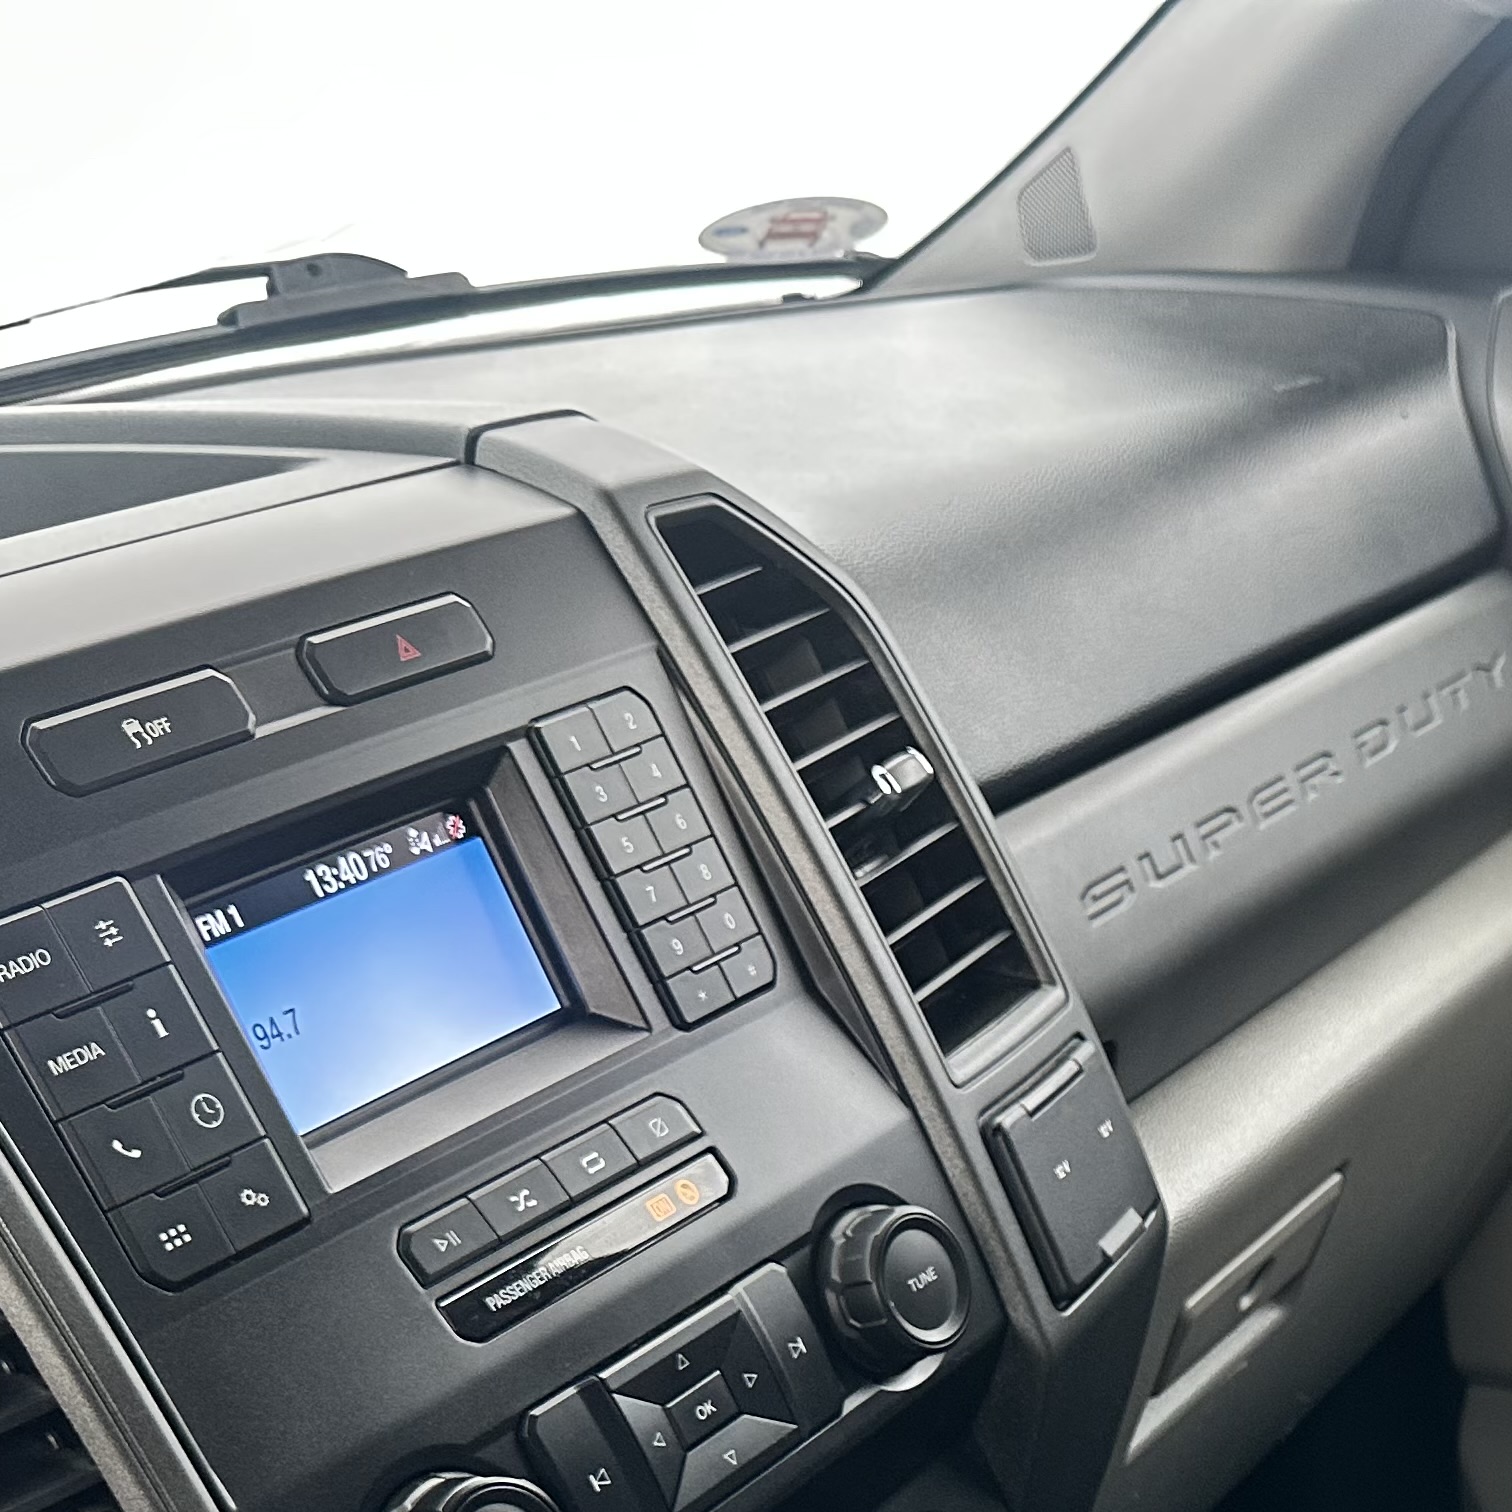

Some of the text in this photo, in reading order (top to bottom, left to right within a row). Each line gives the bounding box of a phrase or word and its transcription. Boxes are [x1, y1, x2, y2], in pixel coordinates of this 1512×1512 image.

[145, 716, 171, 738] OFF
[624, 712, 637, 730] 2
[568, 735, 582, 752] 1
[649, 763, 662, 779] 4
[594, 785, 608, 803] 3
[1078, 650, 1507, 928] SUPER DUTY
[674, 813, 687, 831] 6
[620, 836, 634, 854] 5
[304, 850, 369, 898] 13:40
[698, 863, 712, 881] 8
[645, 884, 657, 903] 7
[195, 903, 246, 942] FM 1
[722, 911, 736, 930] 0
[670, 937, 684, 956] 9
[0, 948, 52, 983] RADIO
[252, 1007, 301, 1050] 94.7
[47, 1042, 106, 1077] MEDIA
[485, 1245, 591, 1312] PASSENGER AIRBAG
[907, 1265, 938, 1292] TUNE
[695, 1399, 717, 1420] OK
